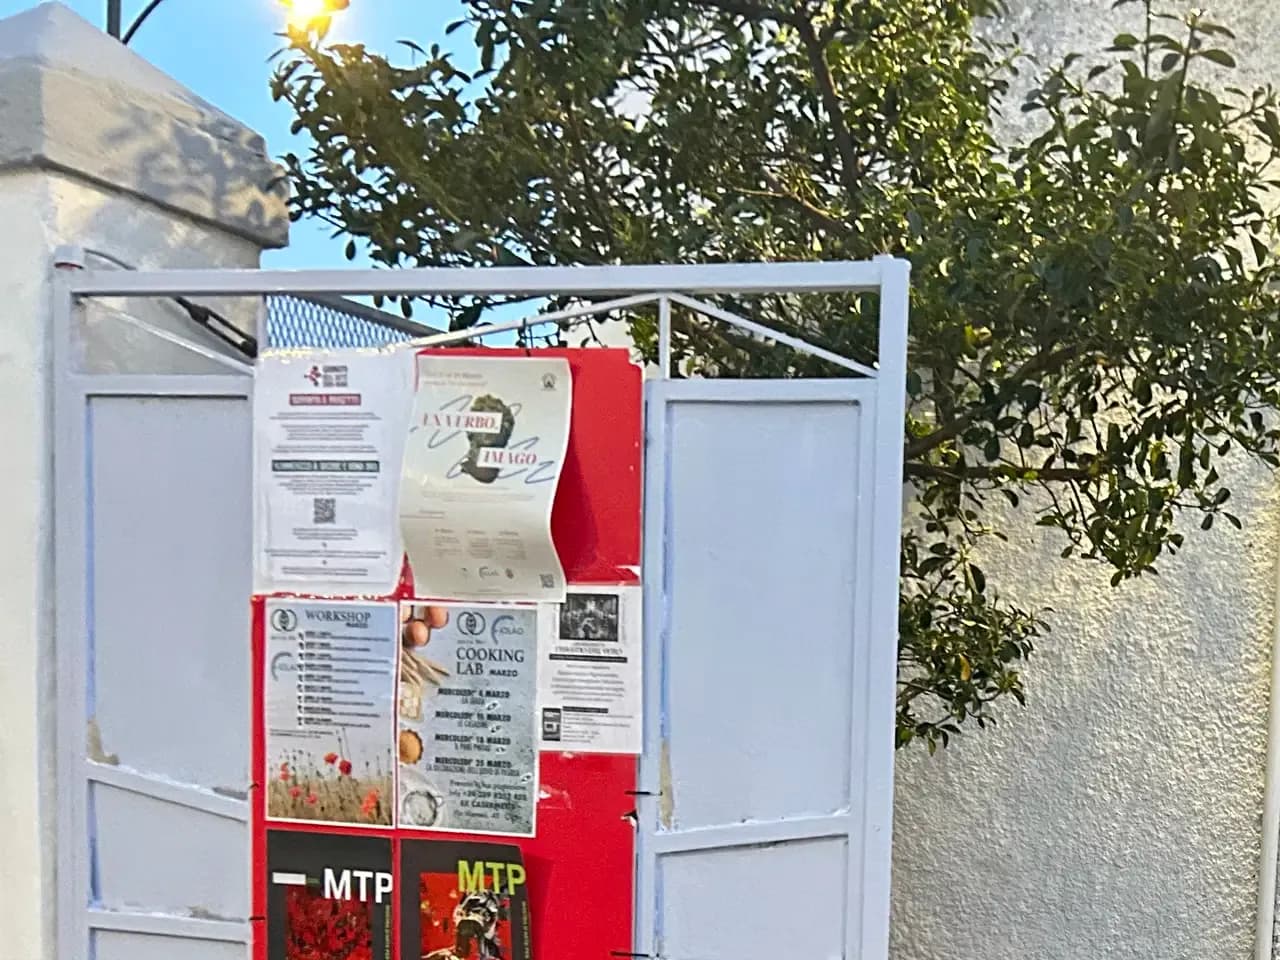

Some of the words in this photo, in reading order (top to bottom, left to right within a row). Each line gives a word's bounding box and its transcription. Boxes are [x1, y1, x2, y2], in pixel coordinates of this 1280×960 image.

[483, 451, 537, 466] IMAGO
[305, 610, 372, 622] WORKSHOP
[456, 647, 525, 663] COOKING
[456, 662, 484, 676] LAB
[489, 669, 518, 677] MARZO
[485, 690, 511, 699] MARZO
[486, 714, 512, 722] MARZO
[486, 737, 512, 746] MARZO
[324, 867, 393, 904] MTP
[458, 860, 526, 896] MTP
